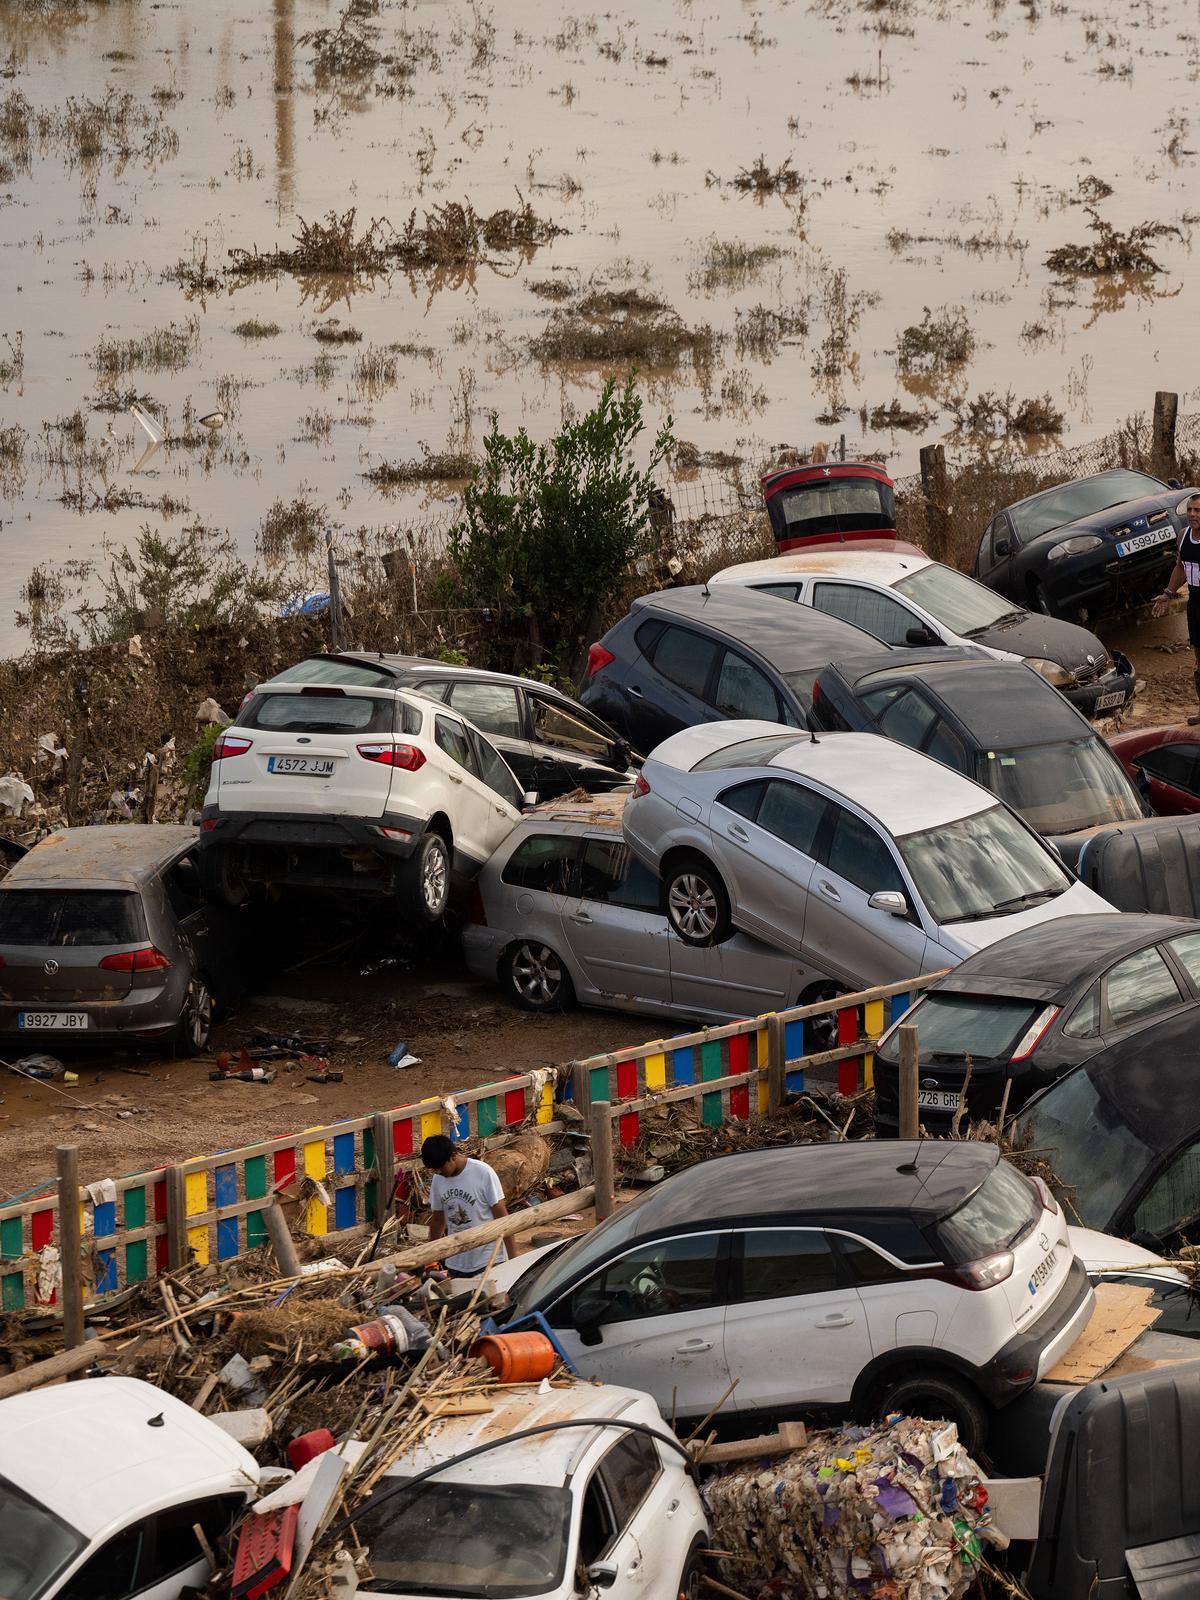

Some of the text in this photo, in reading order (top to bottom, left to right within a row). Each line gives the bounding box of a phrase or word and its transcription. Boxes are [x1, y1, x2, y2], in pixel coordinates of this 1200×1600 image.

[1124, 528, 1171, 553] V 5992 GG
[277, 759, 335, 773] 4572 JJM
[26, 1014, 85, 1027] 9927 JBY
[441, 1188, 476, 1206] ALIFORNIA
